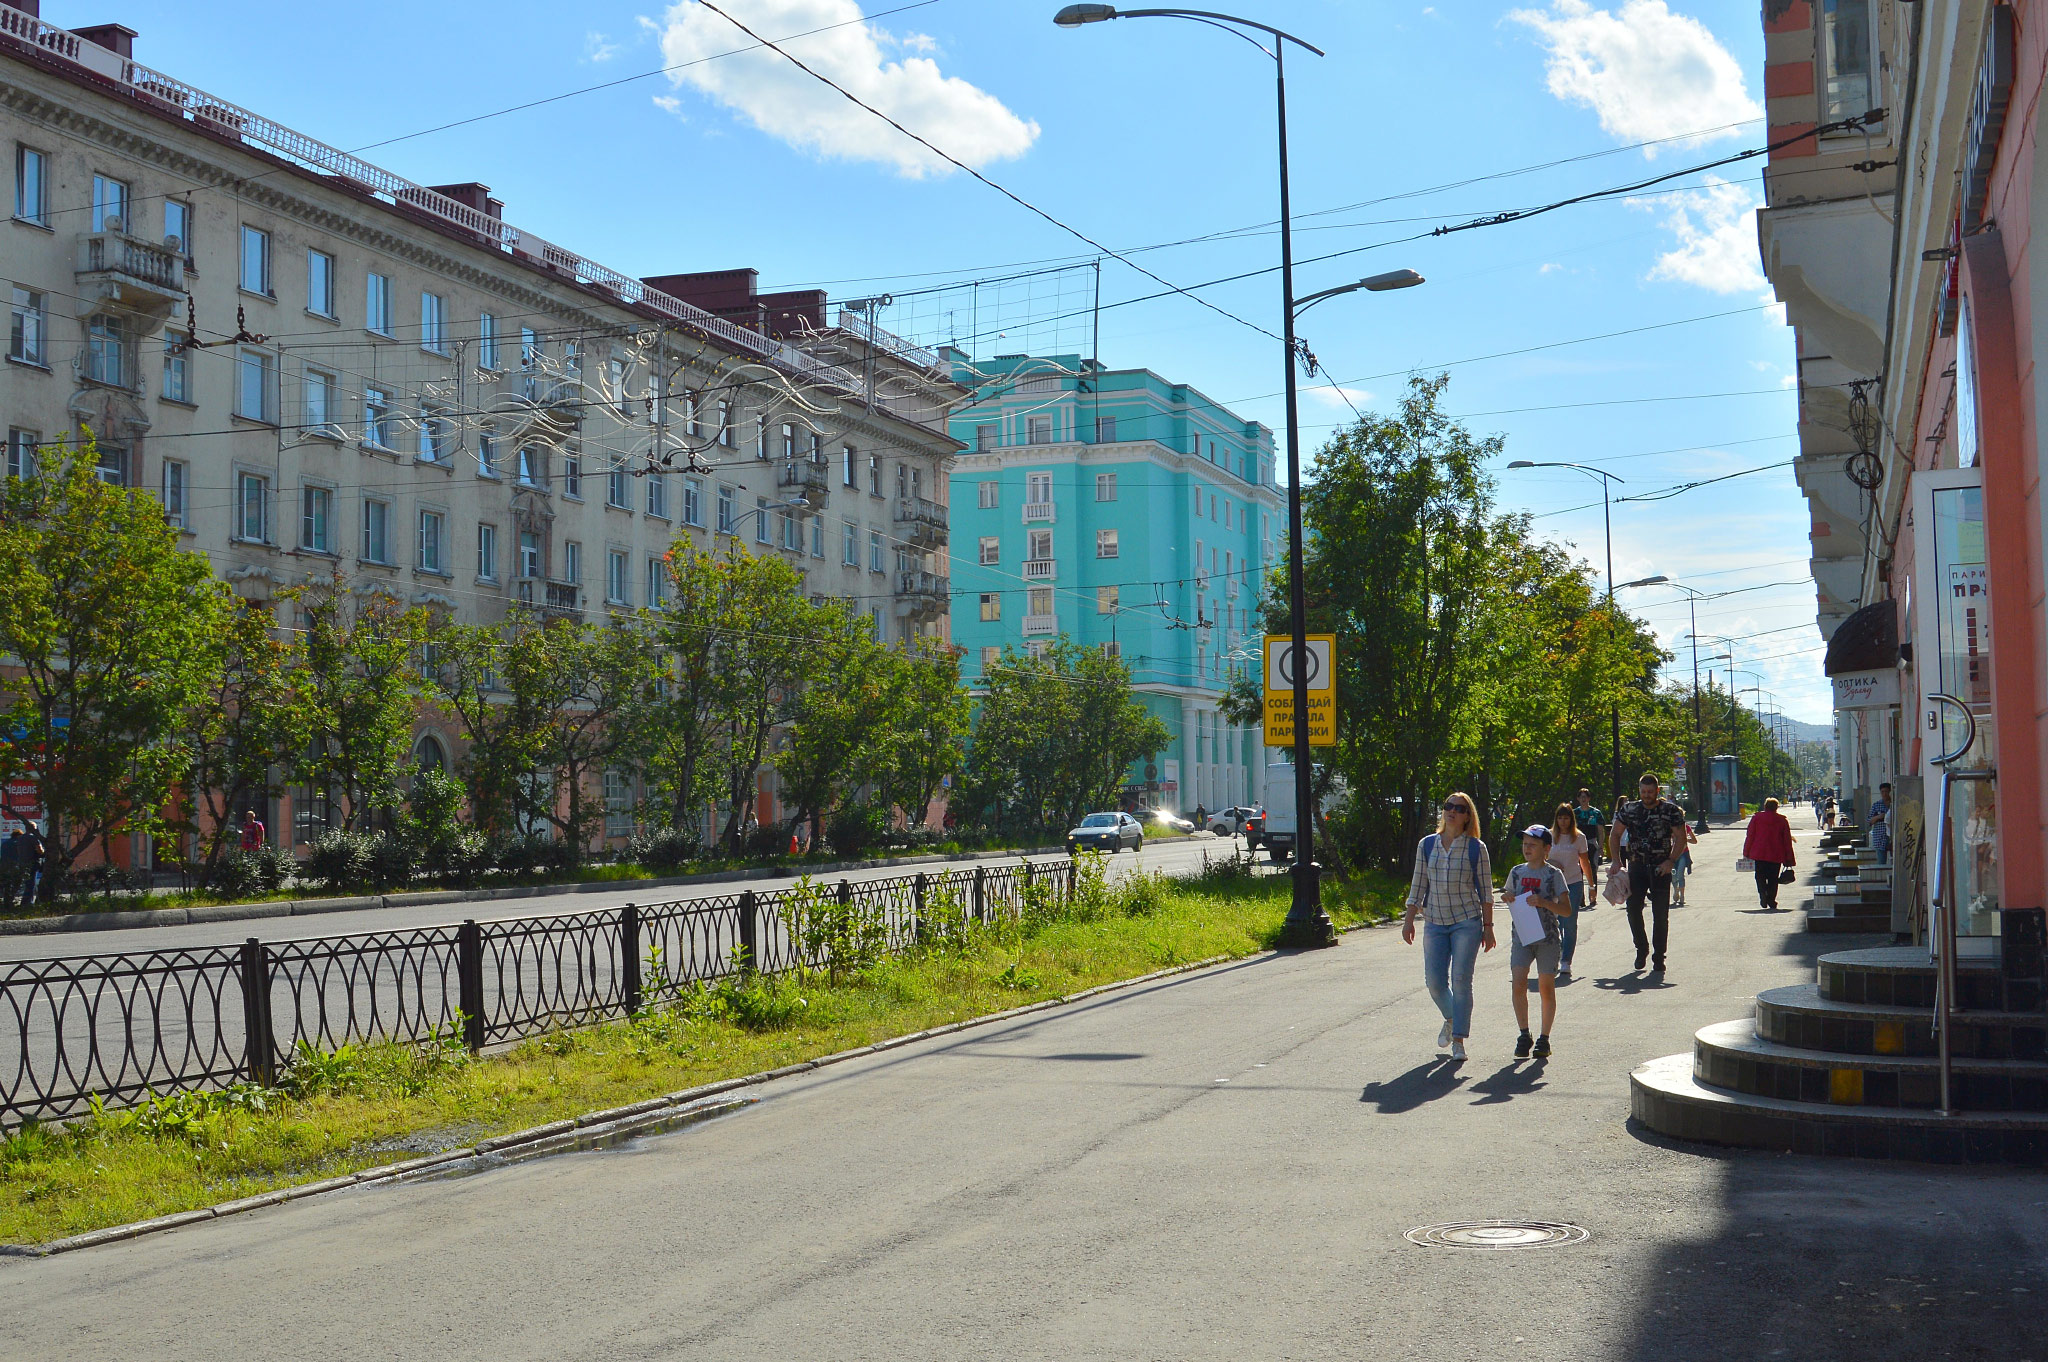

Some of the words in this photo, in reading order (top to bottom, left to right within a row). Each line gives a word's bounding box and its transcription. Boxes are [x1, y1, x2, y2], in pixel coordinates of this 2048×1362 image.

[1838, 677, 1878, 688] ОПТИКА
[1268, 696, 1331, 709] СОБЛДАЙ
[1274, 713, 1325, 722] ПРАЛА
